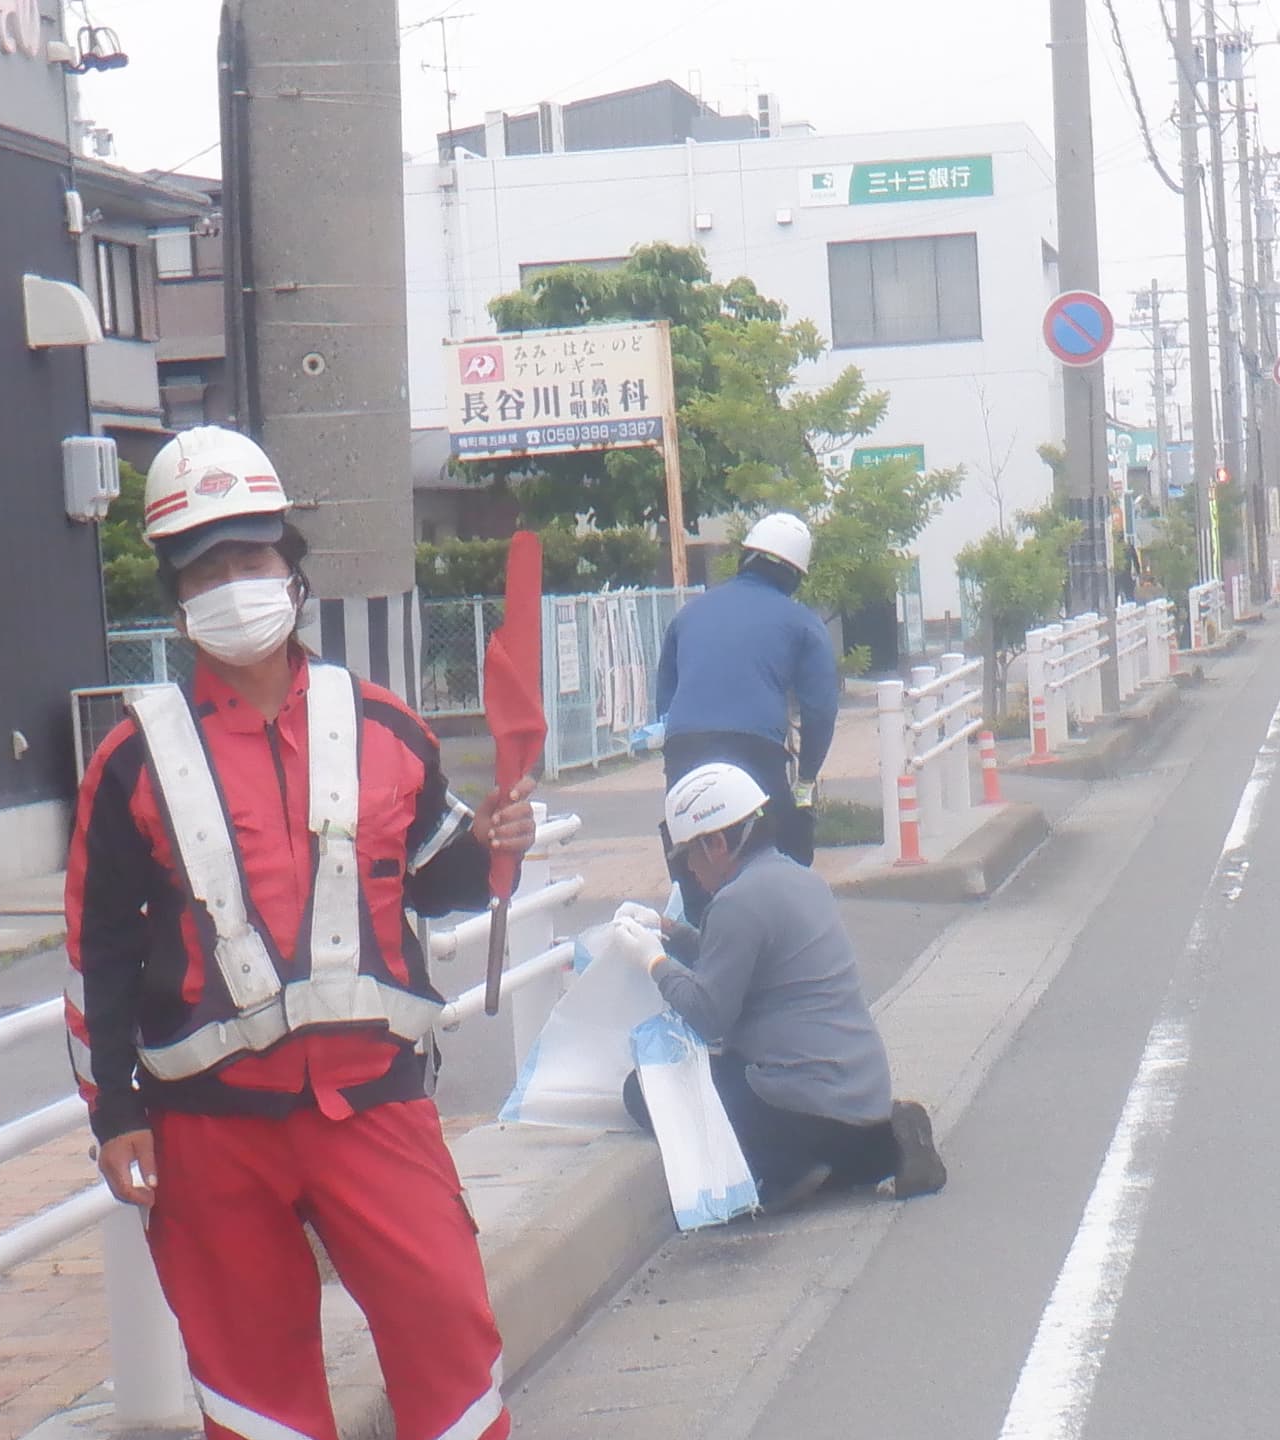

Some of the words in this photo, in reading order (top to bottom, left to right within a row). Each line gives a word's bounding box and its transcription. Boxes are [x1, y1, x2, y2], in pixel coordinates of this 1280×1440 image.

[868, 166, 971, 194] 三十三銀行
[514, 358, 604, 377] アレルギー
